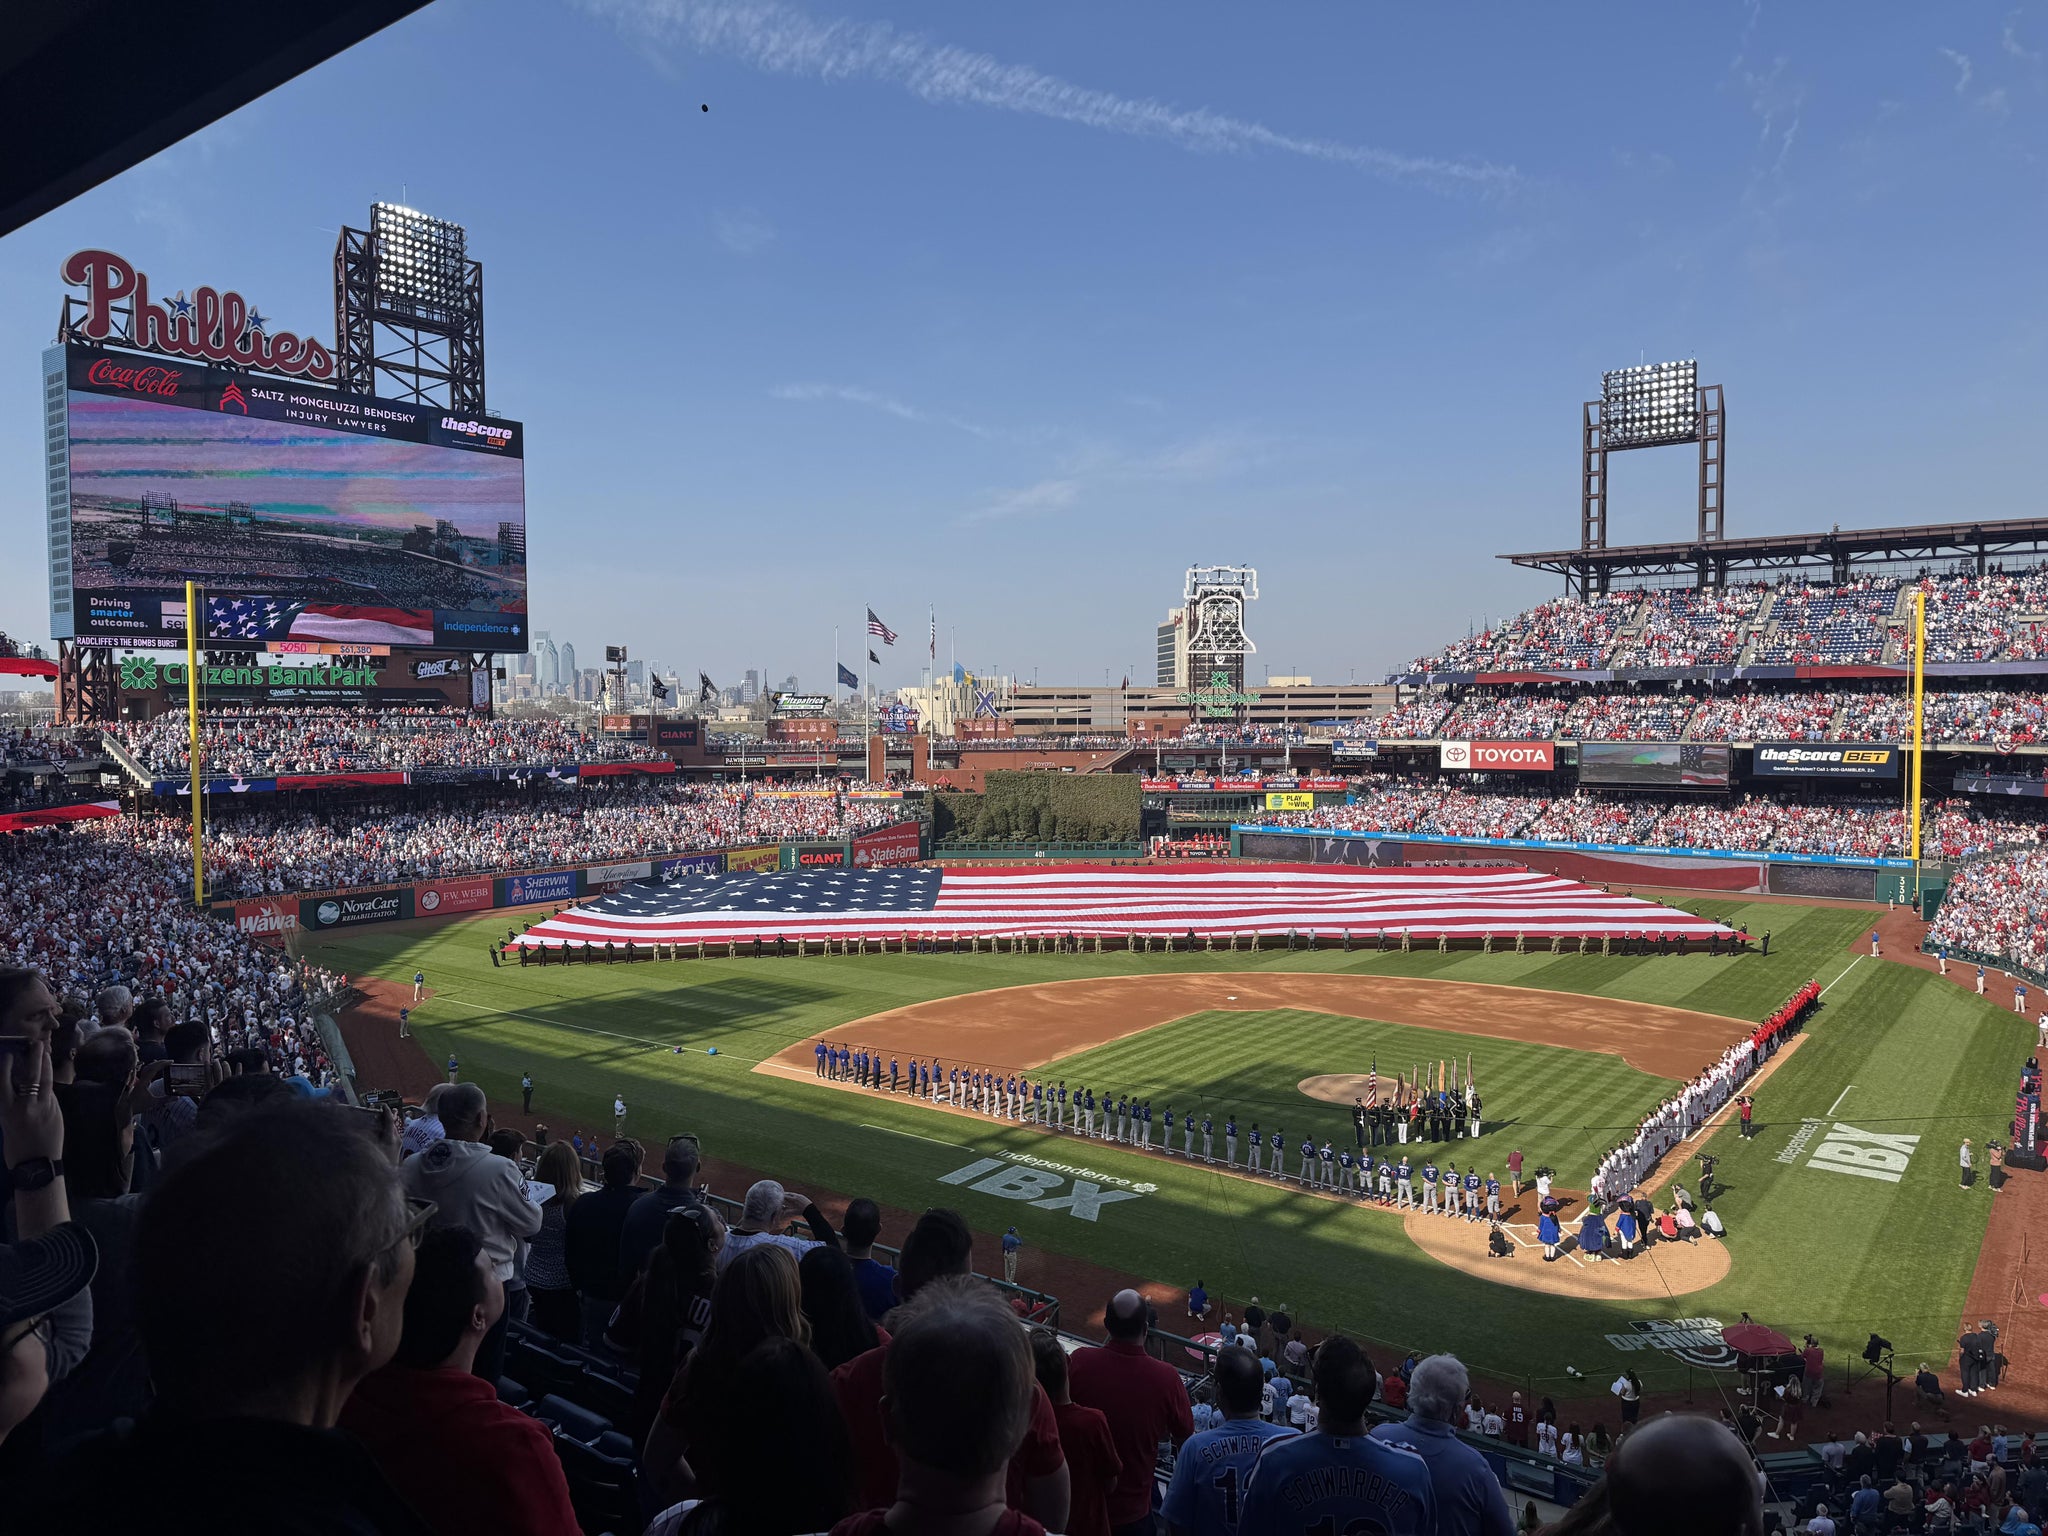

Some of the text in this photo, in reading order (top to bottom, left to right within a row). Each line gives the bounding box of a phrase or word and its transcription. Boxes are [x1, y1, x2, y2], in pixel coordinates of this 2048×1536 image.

[61, 249, 336, 380] Phillies
[88, 358, 183, 397] Coca-Cola
[251, 388, 416, 423] SALTZ MONGELUZZI BENDESKY
[286, 409, 387, 432] INJURY LAWYERS
[441, 417, 513, 439] theScore
[90, 597, 131, 609] Driving
[90, 608, 134, 618] smarter
[90, 619, 149, 628] outcomes.
[444, 622, 509, 633] Independence
[76, 636, 178, 648] RADCLIFFE'S THE BOMBS BURST
[163, 663, 378, 686] Ciizens Bank Park
[417, 659, 452, 679] GHOST
[1177, 692, 1261, 703] Citizens Bank
[1206, 705, 1233, 717] Park
[660, 731, 694, 739] GIANT
[1474, 748, 1548, 763] TOYOTA
[1760, 749, 1885, 762] theScore BET
[1294, 801, 1309, 809] WIN!
[800, 854, 843, 863] GIANT
[871, 847, 895, 862] State
[896, 845, 919, 858] Farm
[395, 879, 436, 889] ASPLUNDH
[442, 875, 481, 884] ASPLUNDH
[525, 875, 569, 889] SHERWIN
[345, 884, 387, 894] ASPLUNDH
[460, 888, 488, 899] WEBB
[235, 895, 283, 905] ASPLUNDH
[293, 890, 337, 901] ASPLUNDH
[341, 897, 399, 914] NovaCare
[342, 910, 397, 922] REHABILITATION
[239, 914, 297, 933] Wawa
[1805, 1122, 1922, 1183] IBX
[996, 1149, 1131, 1187] Independence
[936, 1157, 1144, 1222] IBX
[1673, 1317, 1724, 1329] 2026
[1511, 1412, 1523, 1423] 19
[1201, 1434, 1268, 1464] SCHWAR
[1282, 1465, 1411, 1519] SCHWARBER
